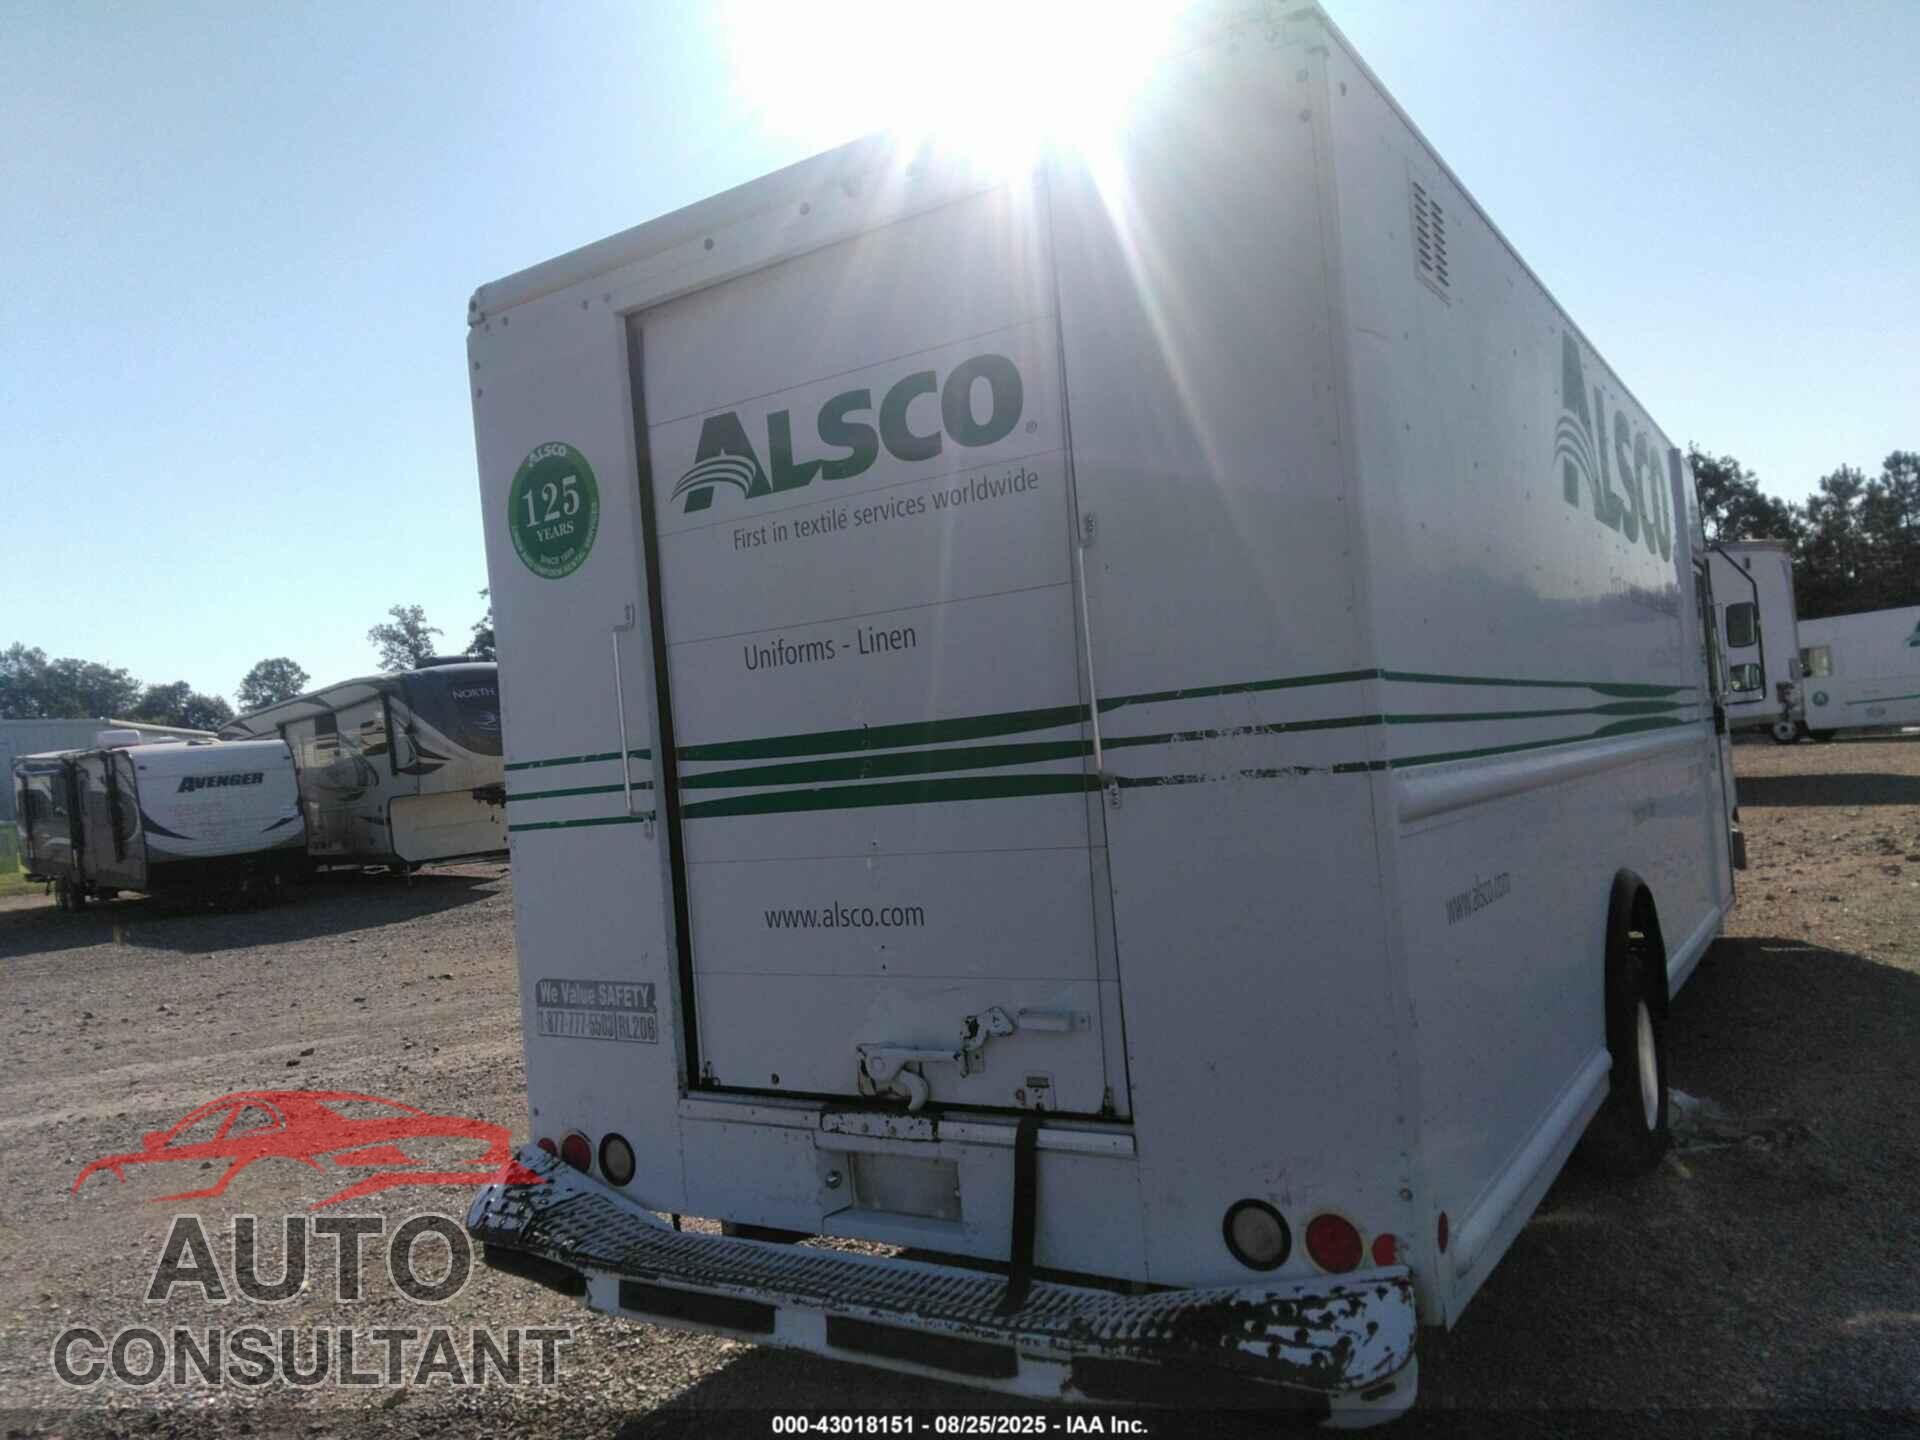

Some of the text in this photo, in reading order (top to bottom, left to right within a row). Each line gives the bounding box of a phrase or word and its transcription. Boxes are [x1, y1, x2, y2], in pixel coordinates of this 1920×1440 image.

[671, 353, 1024, 514] ALSCO
[1552, 329, 1671, 563] ALSCO
[528, 443, 567, 468] ALSCO
[520, 474, 580, 528] 125
[733, 467, 1039, 550] First in textile services worldwide
[536, 520, 575, 542] YEARS
[743, 638, 836, 670] Uniforms
[857, 627, 917, 655] Linen
[452, 687, 497, 699] NORTH
[176, 772, 264, 793] AVENGER
[764, 900, 925, 928] www.alsco.com
[540, 981, 650, 1009] We Value SAFETY
